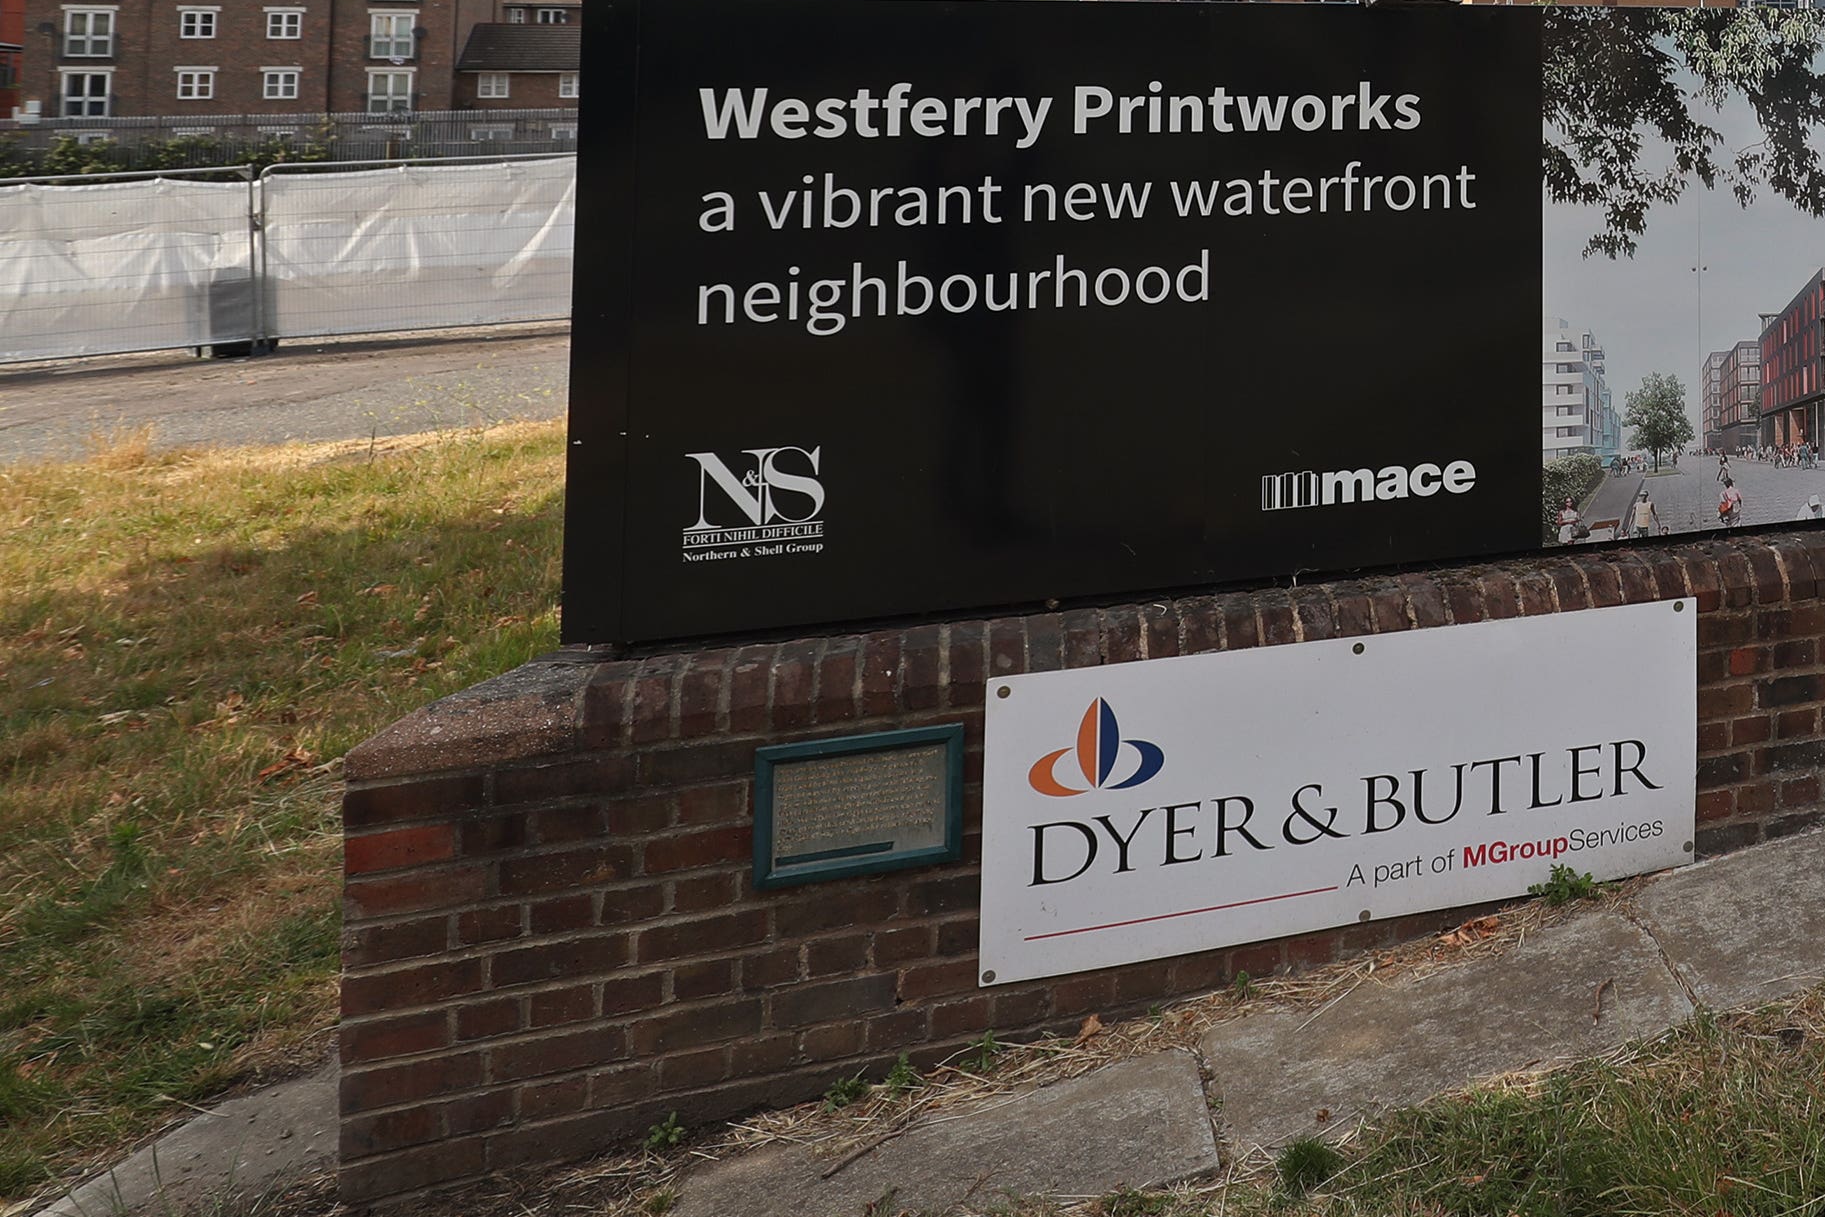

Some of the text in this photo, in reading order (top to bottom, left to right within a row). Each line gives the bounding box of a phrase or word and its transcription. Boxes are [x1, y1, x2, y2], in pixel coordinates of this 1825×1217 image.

[698, 80, 1421, 149] Westferry Printworks
[698, 160, 1477, 233] a vibrant new waterfront
[698, 248, 1209, 336] neighbourhood
[1320, 459, 1477, 506] mace
[682, 524, 824, 546] FORTI NIHIL DIFFICILE
[682, 543, 824, 563] Northern & Shell Group
[1027, 795, 1275, 888] DYER
[1282, 783, 1351, 846] &
[1360, 739, 1664, 835] BUTLER
[1346, 863, 1366, 888] A
[1374, 855, 1424, 889] part
[1431, 848, 1457, 874] of
